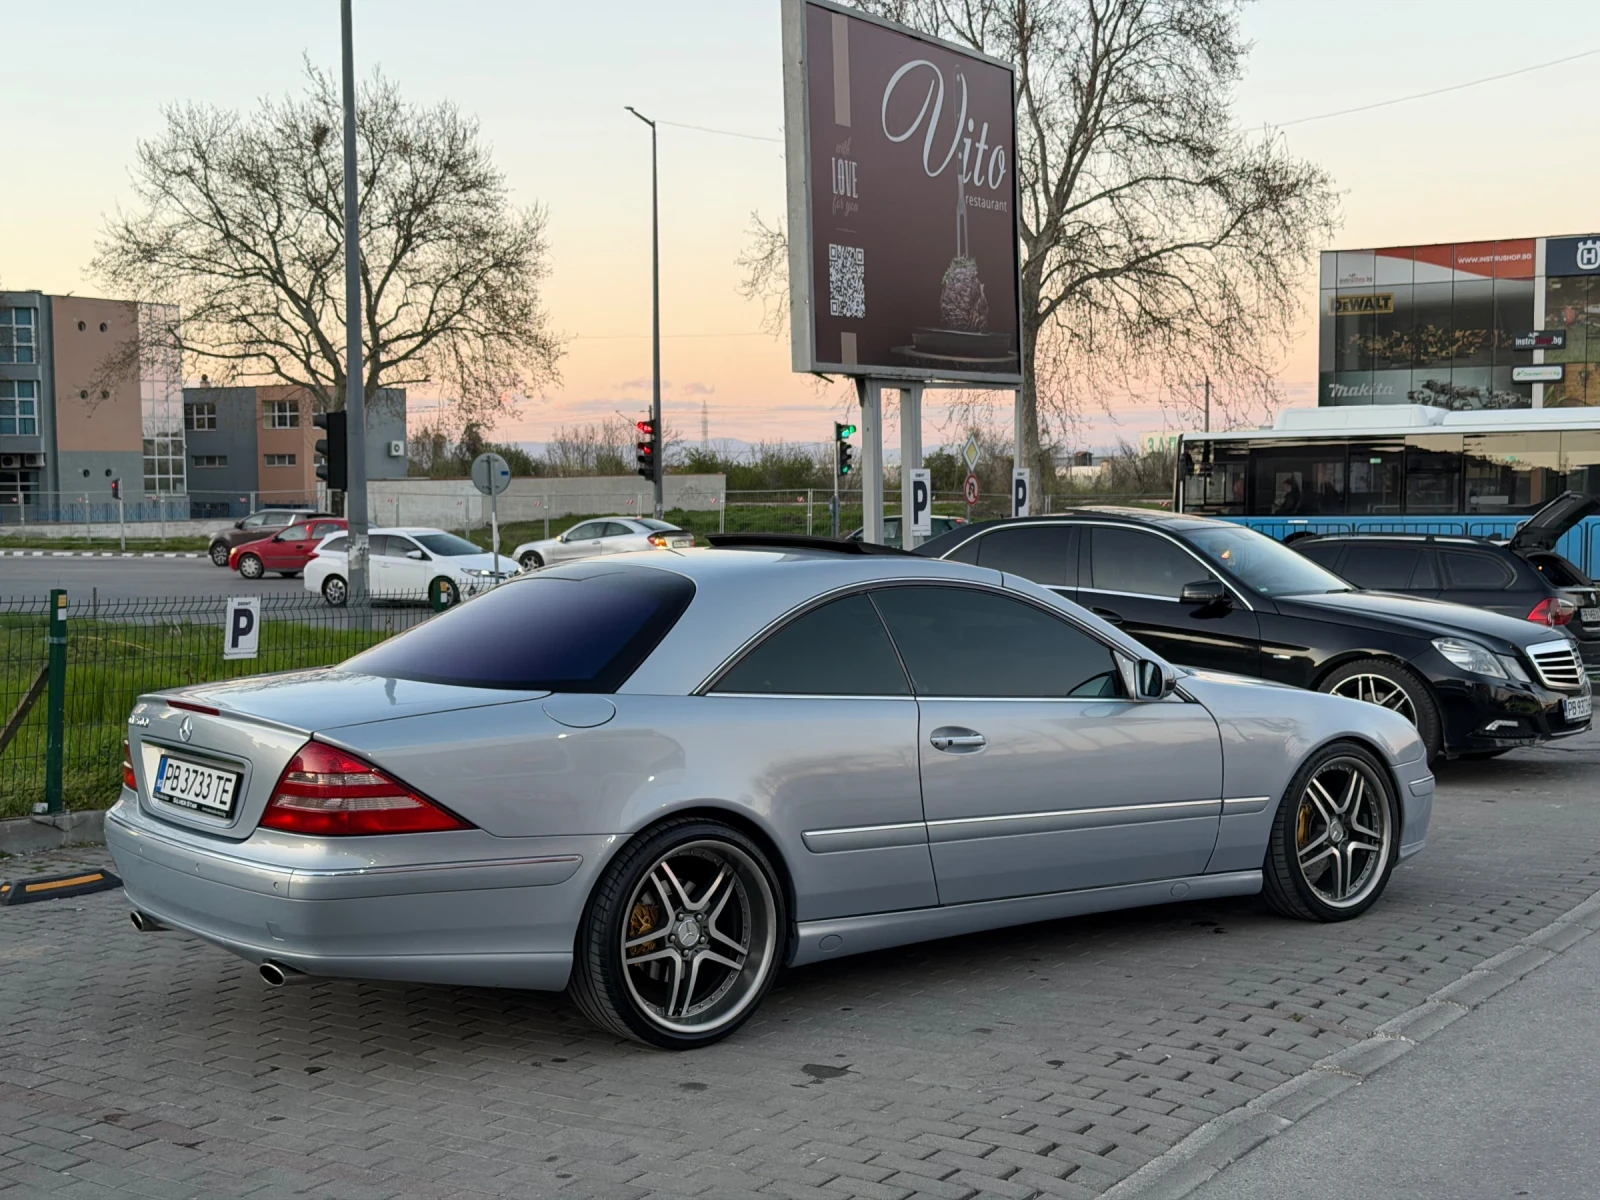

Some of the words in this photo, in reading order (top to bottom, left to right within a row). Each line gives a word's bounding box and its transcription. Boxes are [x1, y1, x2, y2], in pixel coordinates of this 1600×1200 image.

[881, 59, 1007, 190] Vito
[831, 157, 859, 198] LOVE
[844, 201, 859, 217] you
[965, 194, 1007, 213] restaurant
[913, 480, 928, 525] P
[1015, 478, 1027, 517] P
[231, 608, 254, 648] P
[163, 763, 181, 792] PB
[180, 767, 213, 800] 3733
[213, 775, 232, 806] TE
